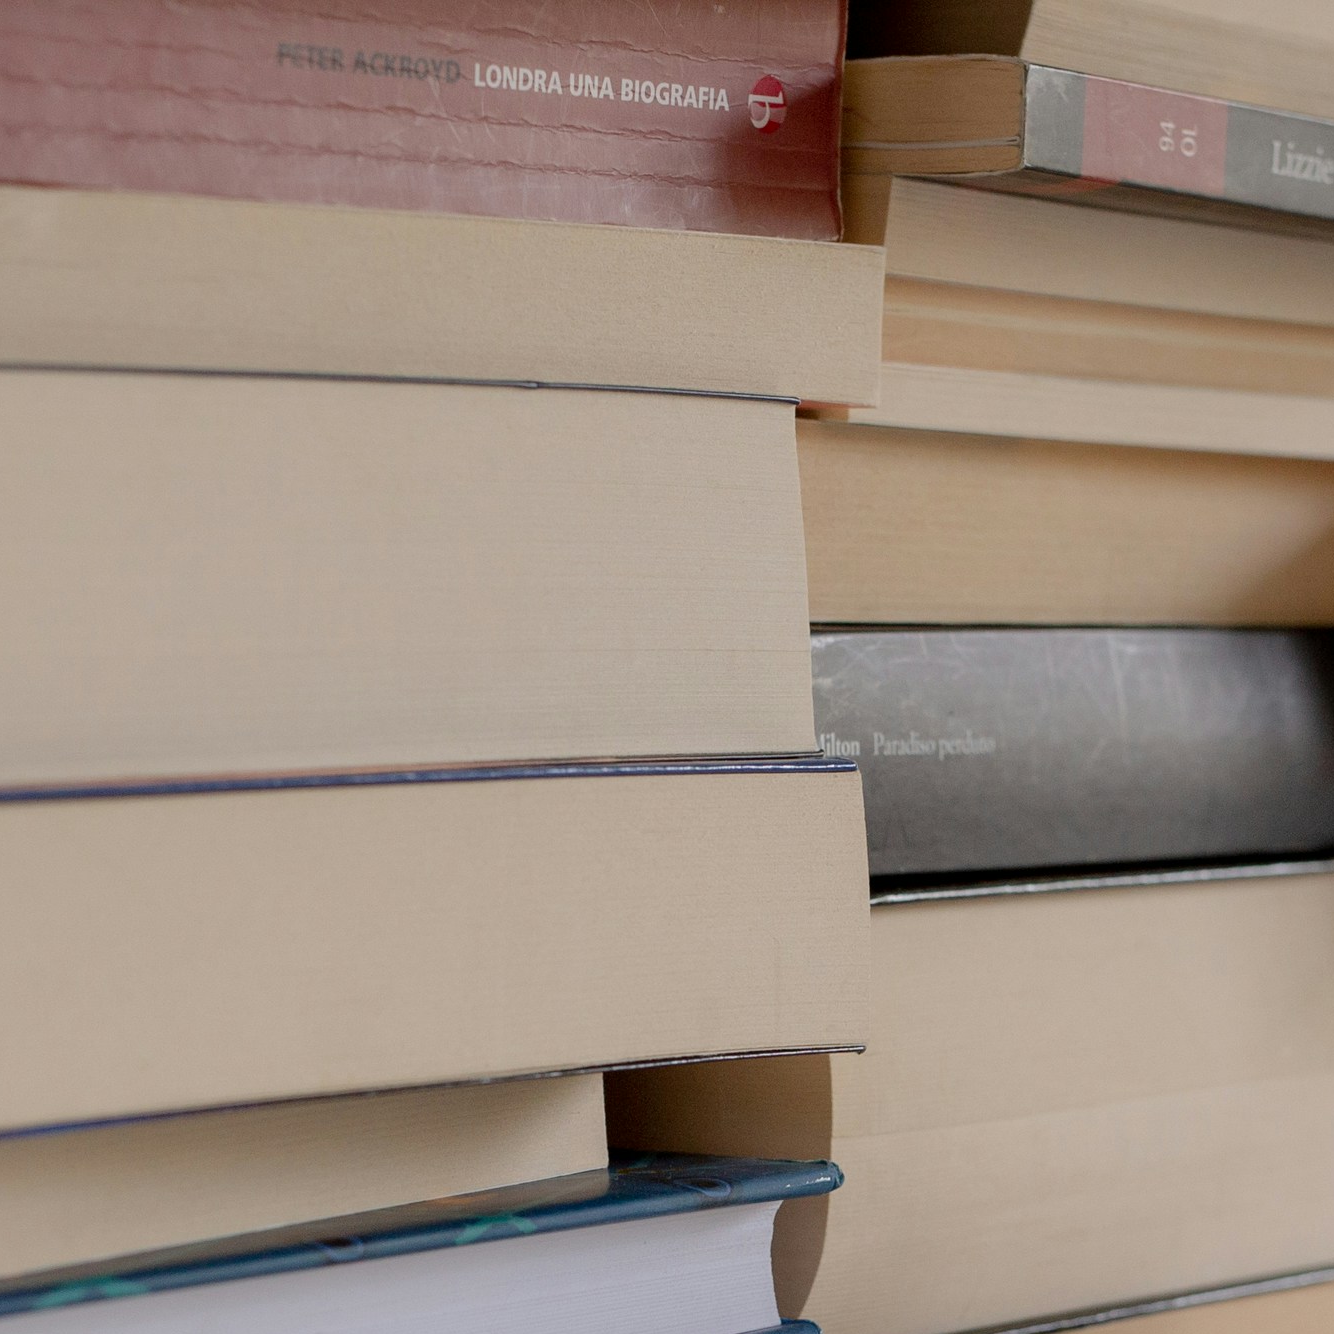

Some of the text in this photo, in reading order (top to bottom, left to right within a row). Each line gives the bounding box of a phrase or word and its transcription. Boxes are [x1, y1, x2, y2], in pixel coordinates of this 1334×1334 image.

[277, 43, 730, 111] PETER ACKROYD LONDRA UNA BIOGRAFIA
[873, 731, 936, 757] Paradiso
